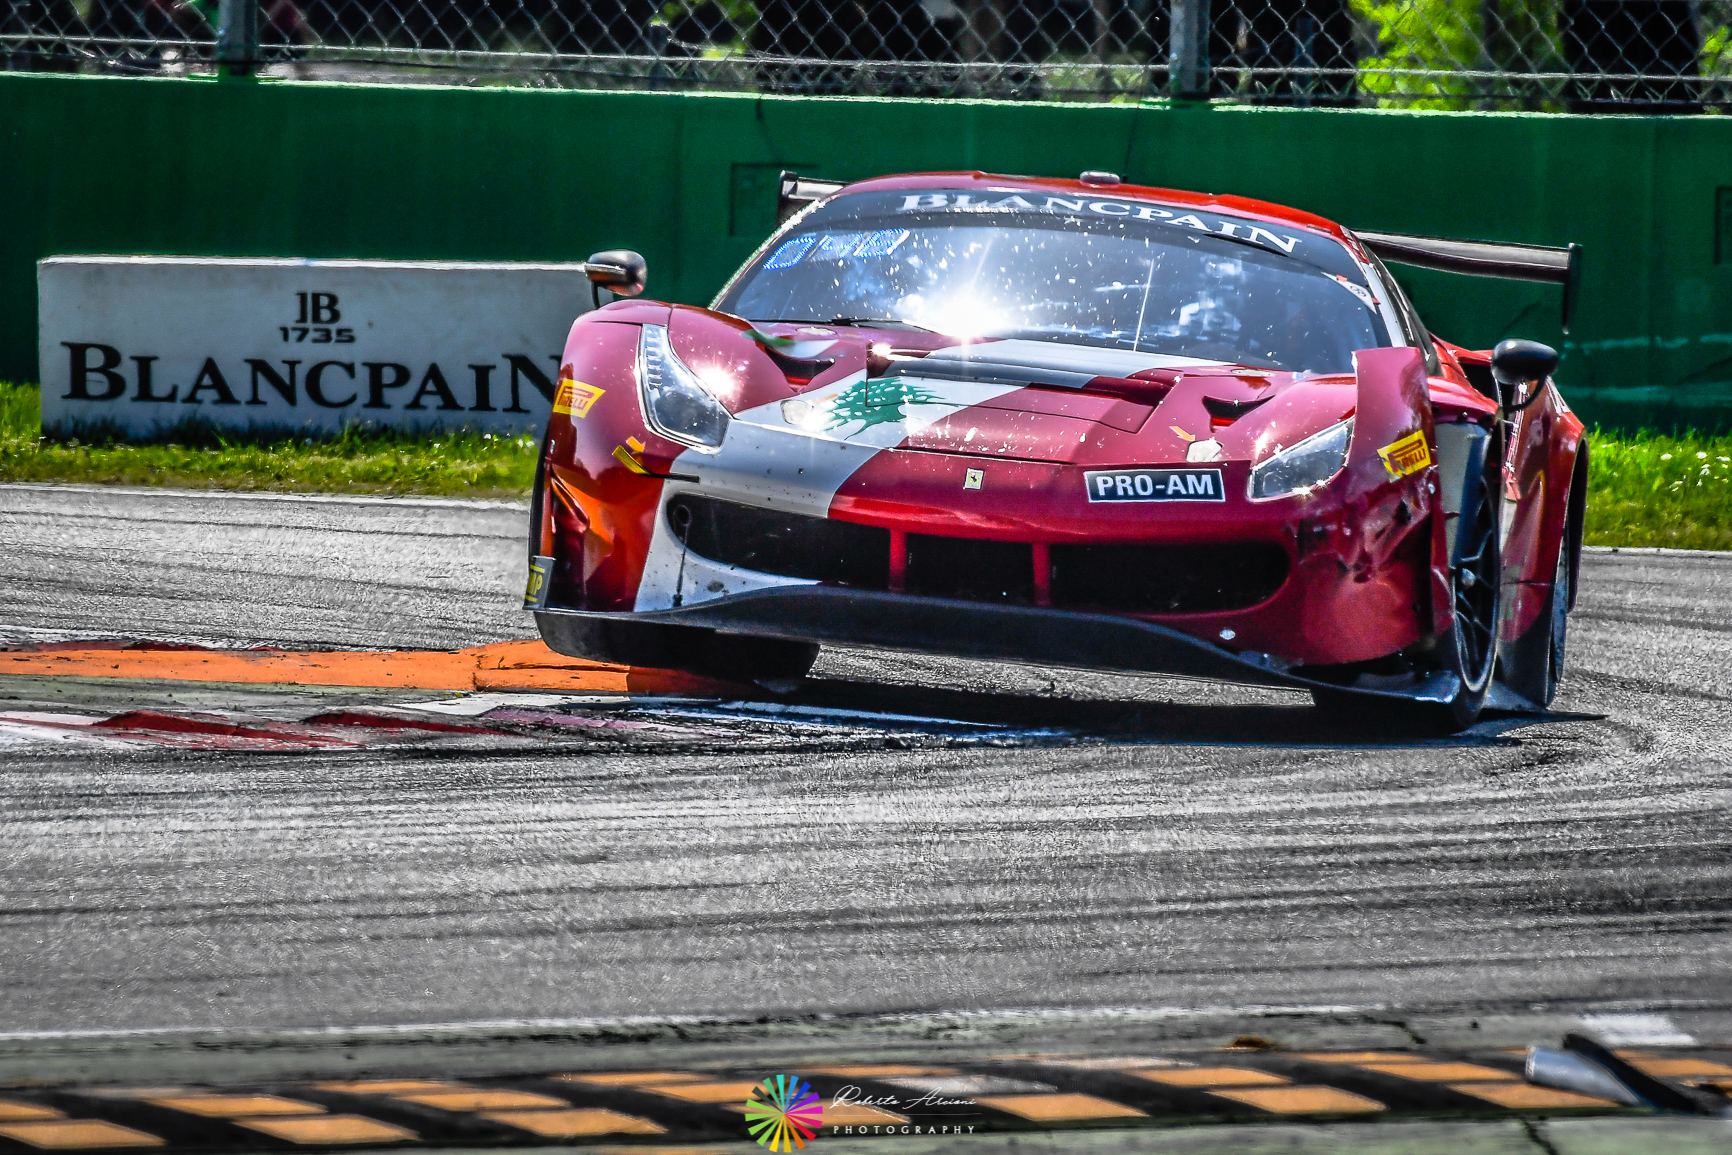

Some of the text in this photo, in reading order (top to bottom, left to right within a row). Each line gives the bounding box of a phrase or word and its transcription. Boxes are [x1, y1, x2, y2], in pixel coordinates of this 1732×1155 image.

[898, 193, 1301, 254] BLANCPAIN
[279, 326, 356, 343] 1735
[60, 340, 561, 414] BLANCPAIN
[1095, 474, 1214, 496] PRO-AM
